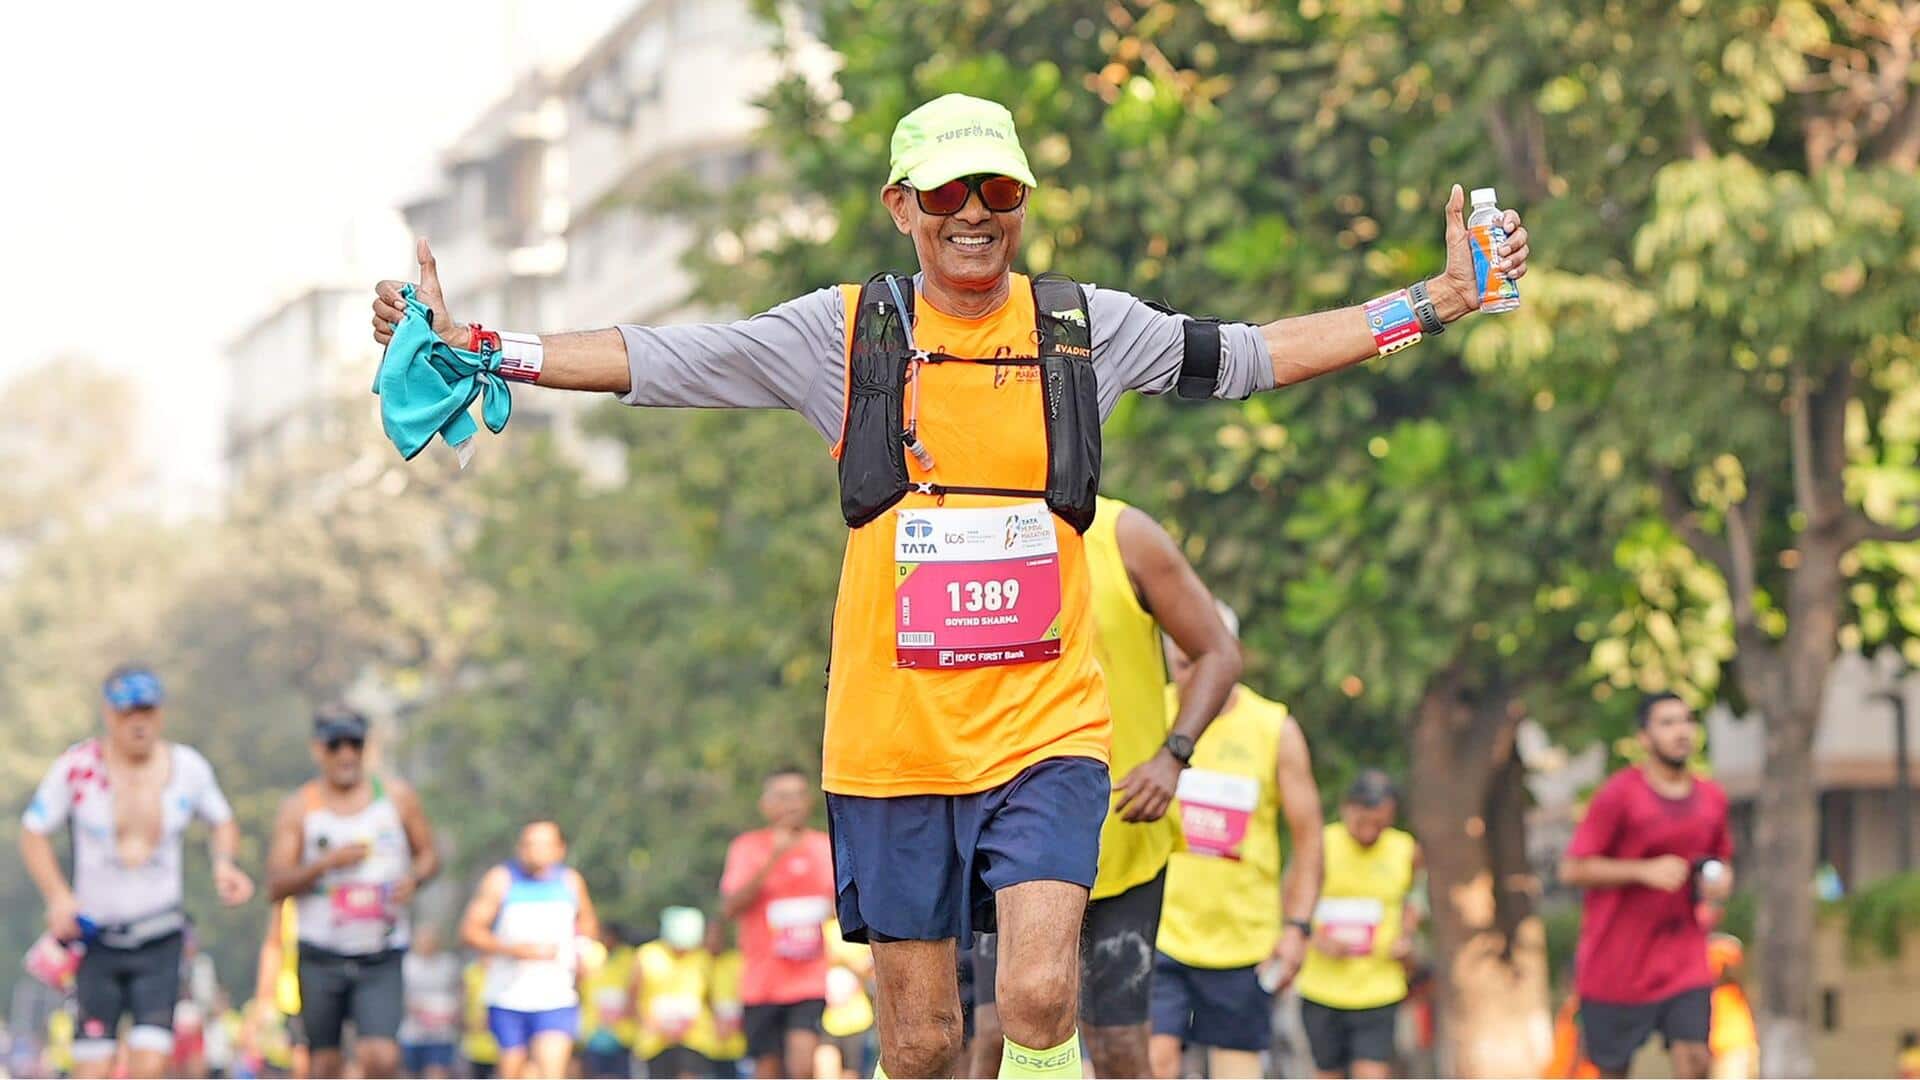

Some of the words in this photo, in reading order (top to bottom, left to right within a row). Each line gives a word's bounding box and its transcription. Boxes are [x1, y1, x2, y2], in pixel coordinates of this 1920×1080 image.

[1055, 343, 1091, 357] EVADICT
[944, 532, 965, 544] tcs
[901, 543, 937, 554] TATA
[900, 566, 907, 576] D
[946, 578, 1020, 612] 1389
[945, 616, 980, 627] GOVIND
[981, 615, 1019, 626] SHARMA
[955, 652, 977, 663] IDFC
[978, 651, 1004, 662] FIRST
[1005, 649, 1024, 660] Bank
